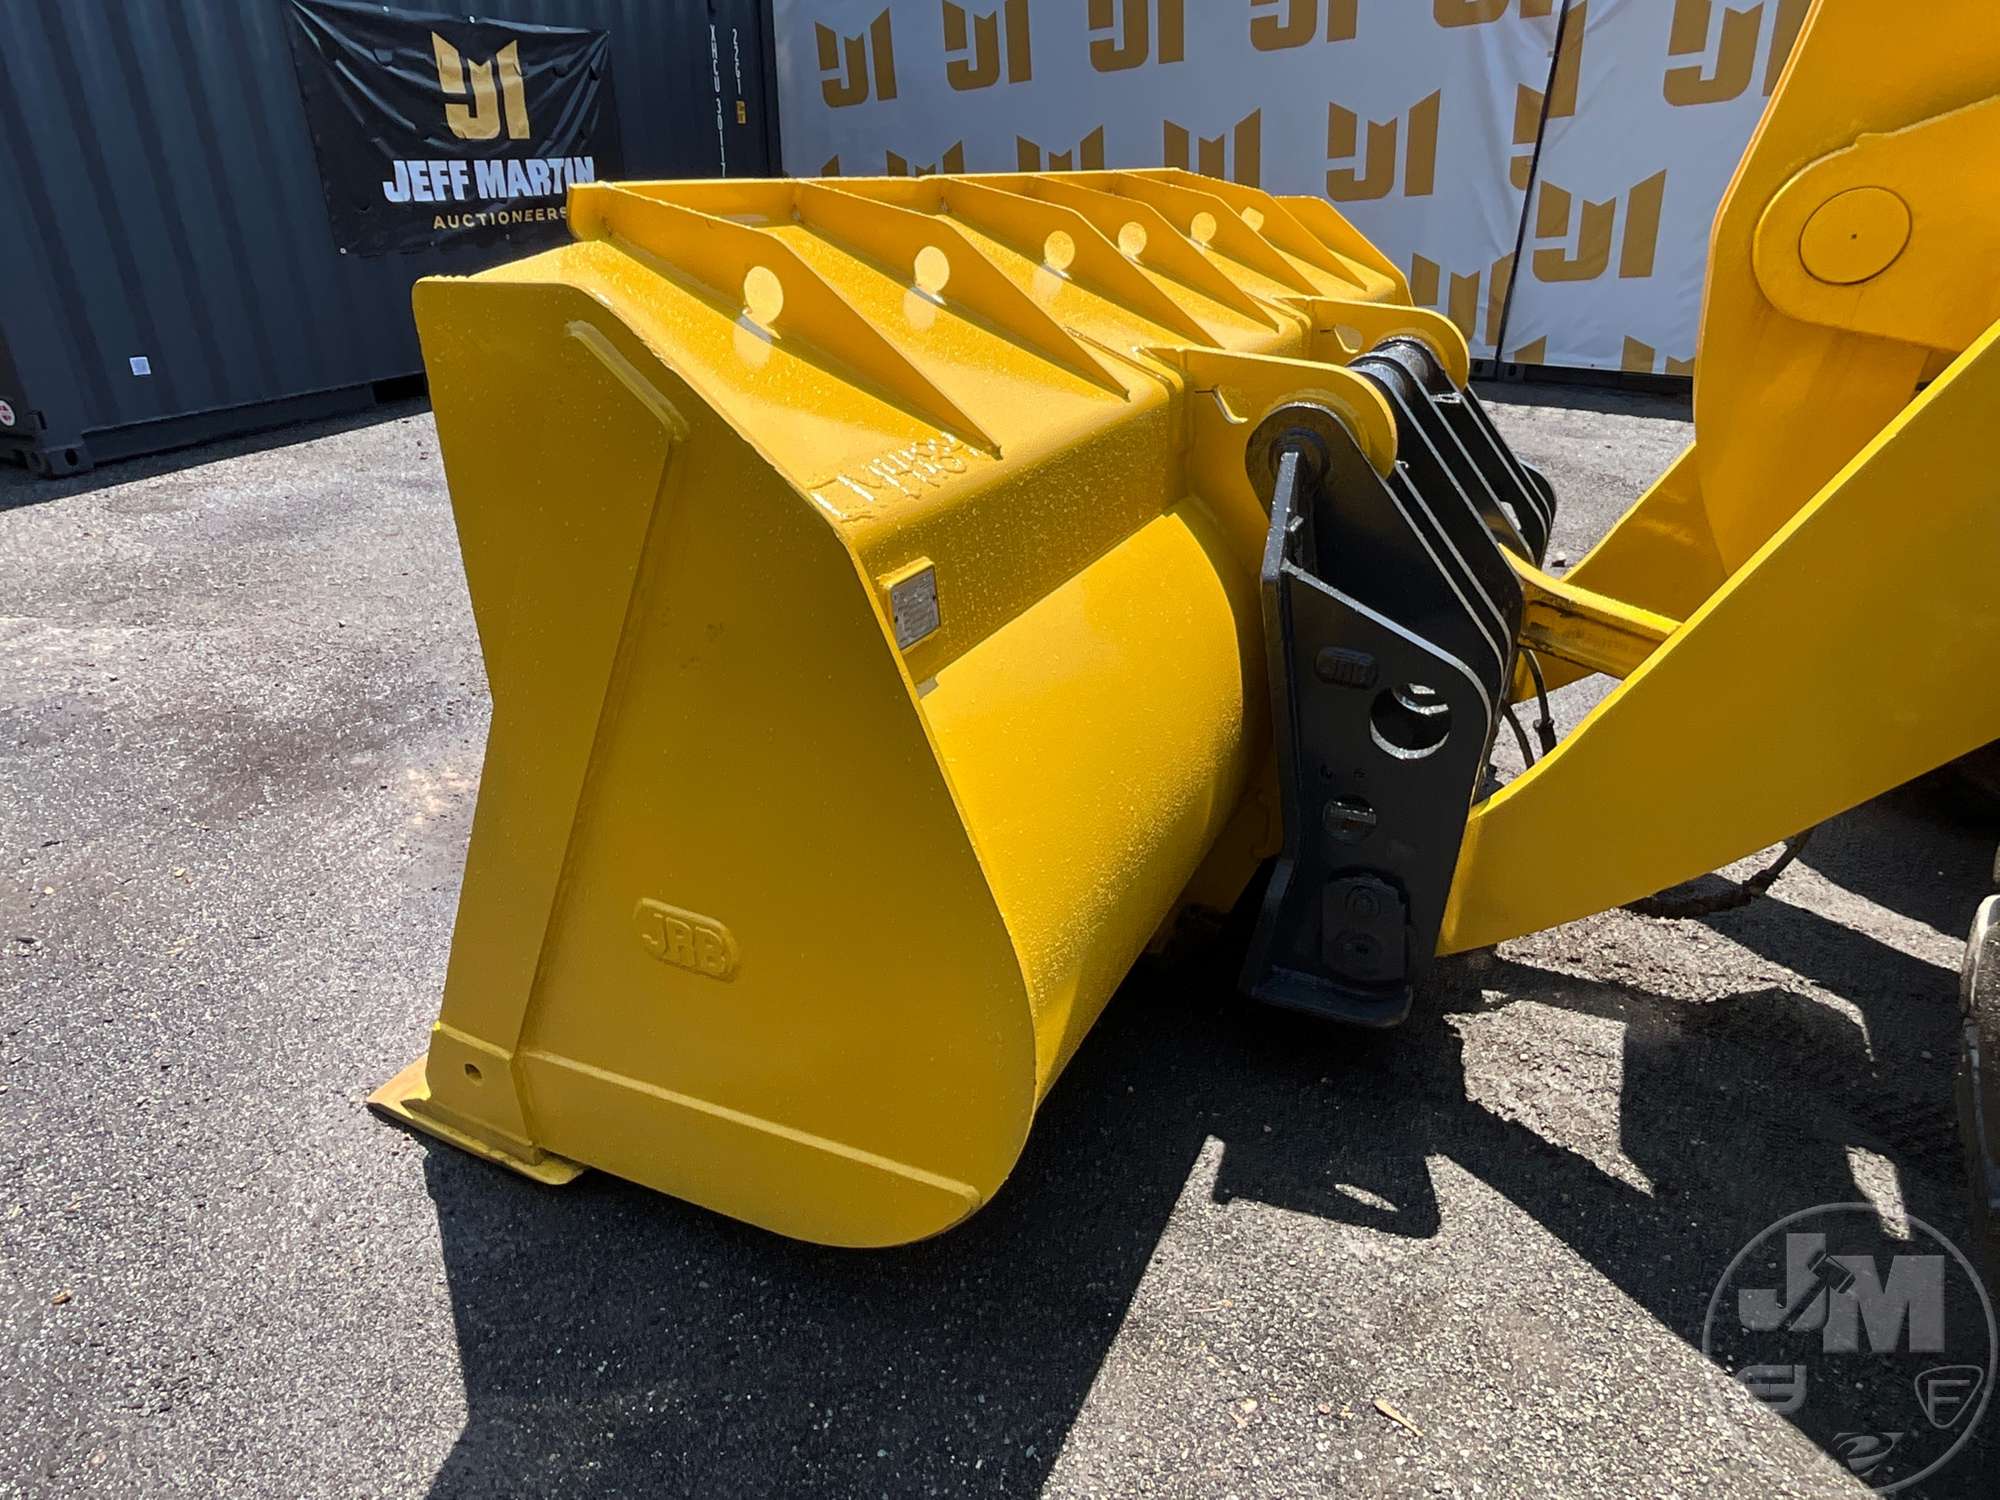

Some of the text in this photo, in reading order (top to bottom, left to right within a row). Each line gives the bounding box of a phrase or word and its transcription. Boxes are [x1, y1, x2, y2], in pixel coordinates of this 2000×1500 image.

[382, 156, 595, 203] JEFF MARTIN
[641, 912, 727, 975] JRB
